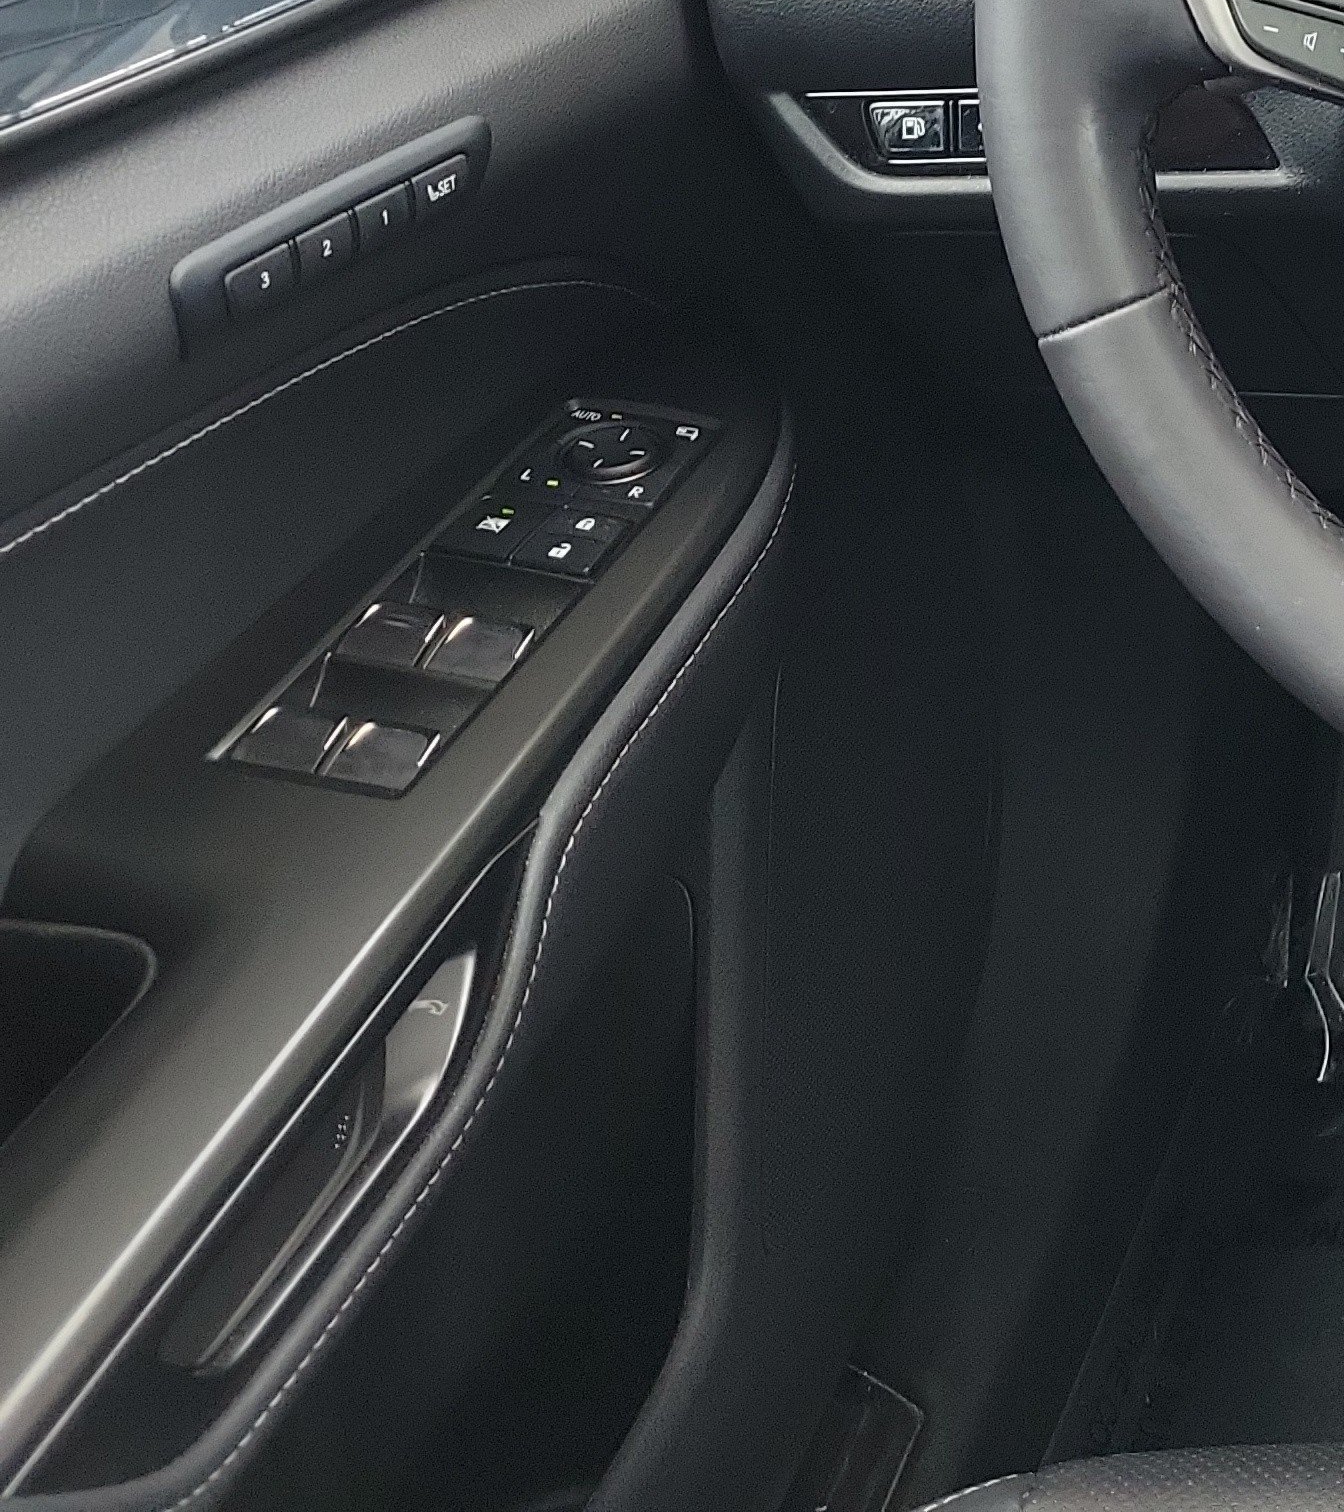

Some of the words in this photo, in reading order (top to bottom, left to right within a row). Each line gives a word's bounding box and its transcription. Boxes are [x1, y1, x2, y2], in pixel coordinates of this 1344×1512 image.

[437, 174, 456, 195] SET
[382, 210, 388, 225] 1
[323, 239, 332, 256] 2
[260, 271, 270, 288] 3
[571, 410, 601, 421] AUTO
[520, 469, 531, 481] L
[628, 486, 644, 498] R
